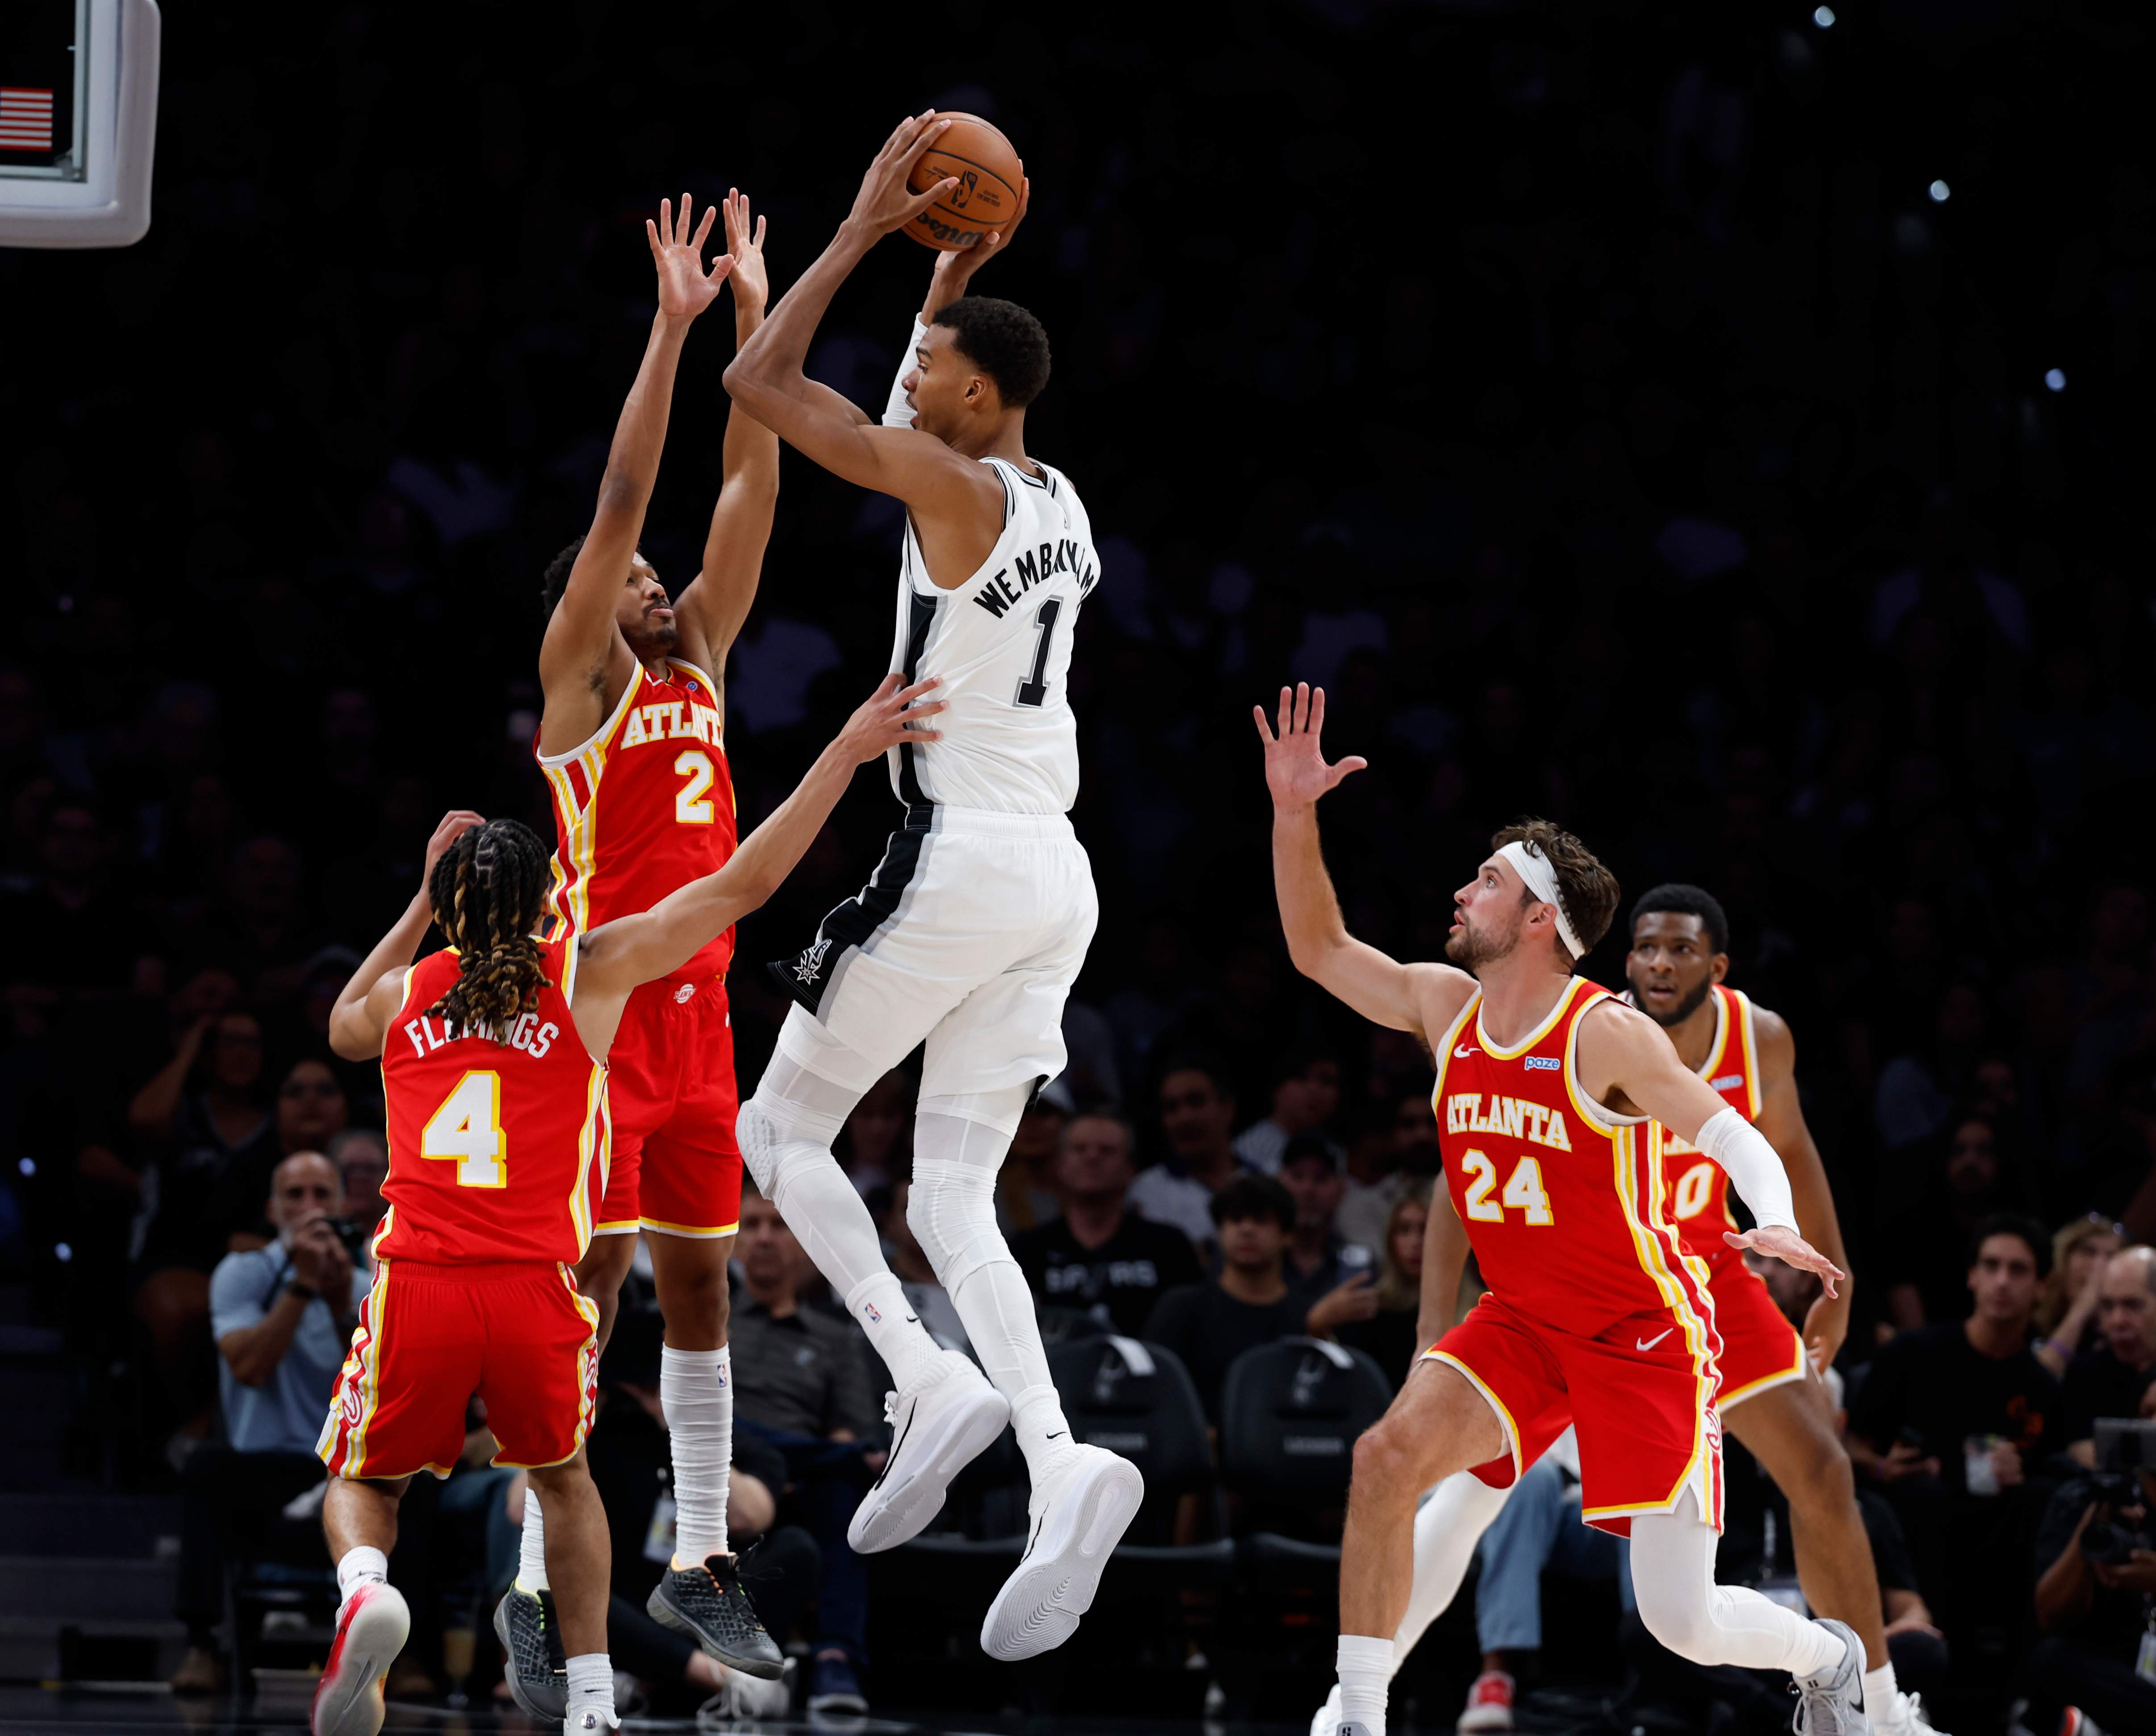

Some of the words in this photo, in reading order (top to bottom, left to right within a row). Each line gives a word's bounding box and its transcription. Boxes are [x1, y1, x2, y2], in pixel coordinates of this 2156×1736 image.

[916, 212, 984, 245] Wilso
[1012, 594, 1064, 709] 1
[620, 700, 725, 758] ATLNT
[674, 750, 714, 824] 2
[1524, 1056, 1560, 1071] paze
[421, 1070, 507, 1188] 4
[1447, 1093, 1572, 1153] ATLANTA
[1462, 1148, 1554, 1226] 24
